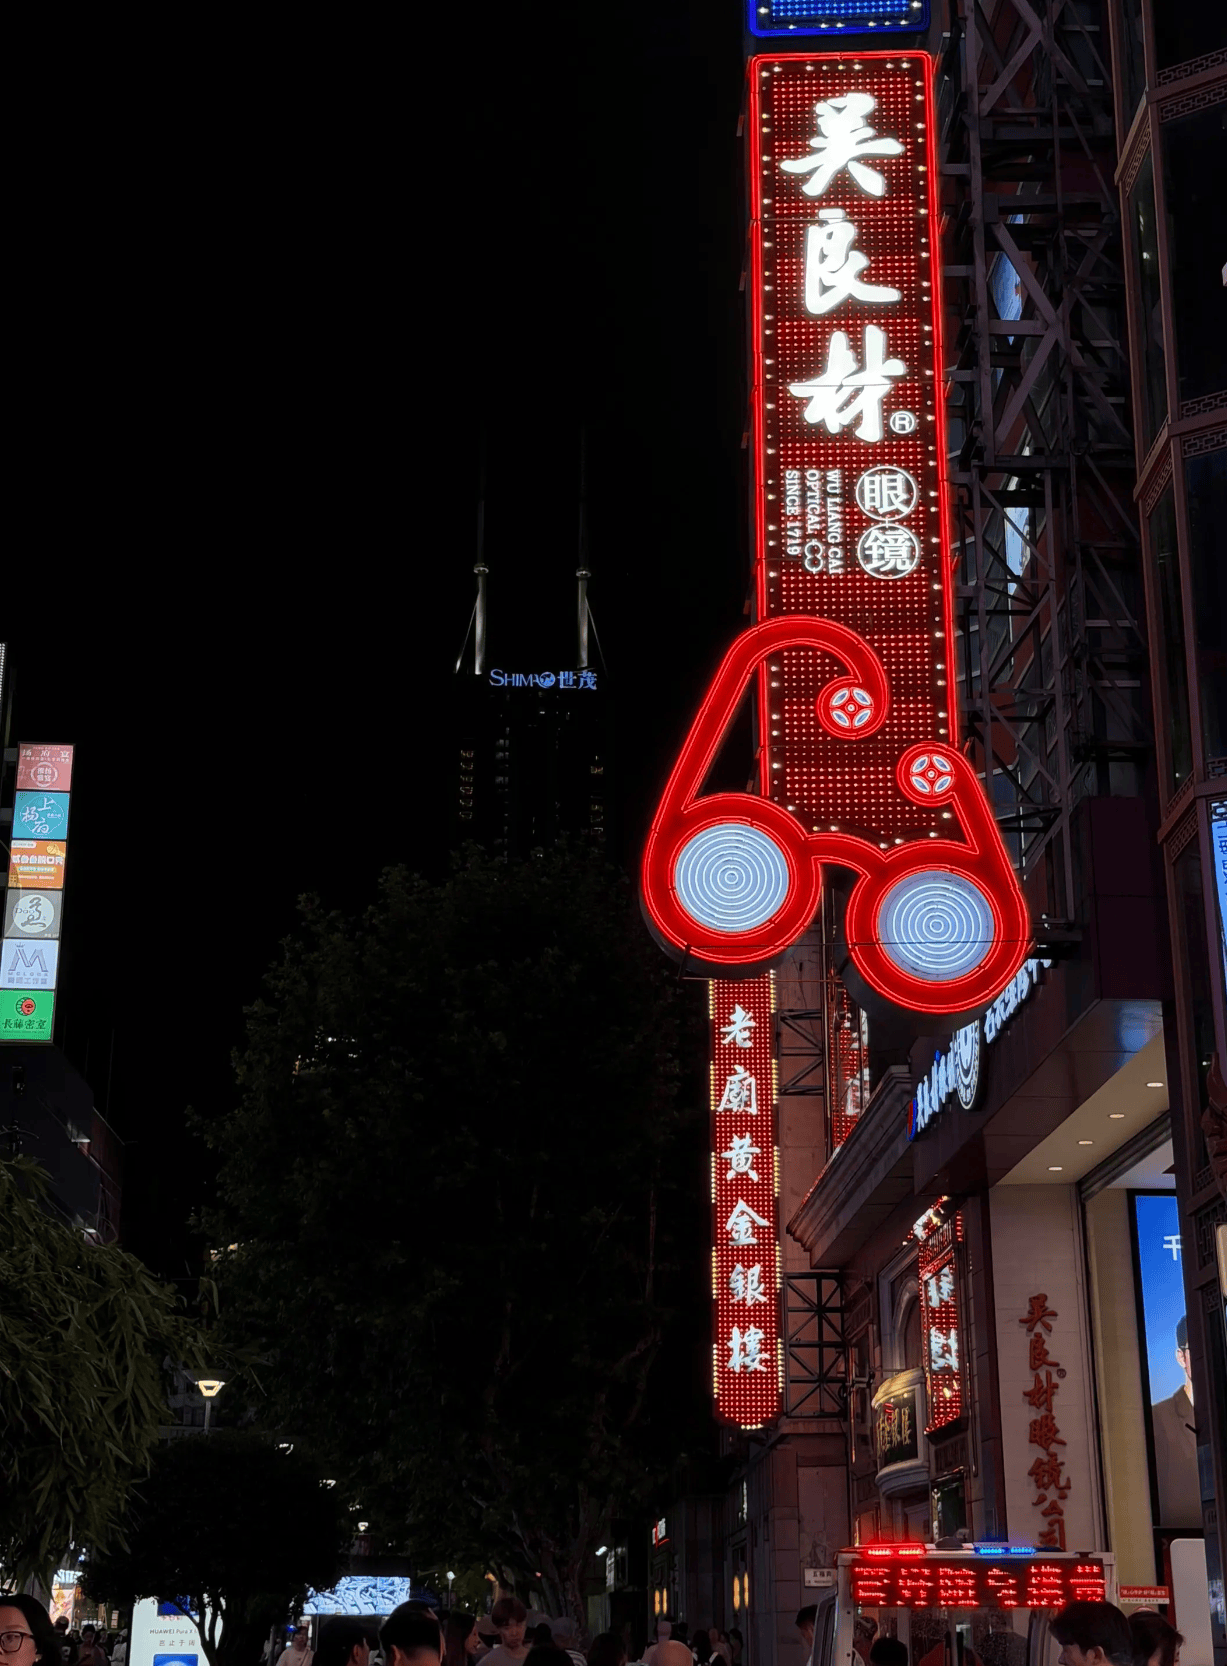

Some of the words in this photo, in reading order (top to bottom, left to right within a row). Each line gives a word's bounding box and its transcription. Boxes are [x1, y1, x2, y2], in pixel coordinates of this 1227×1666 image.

[778, 91, 905, 442] 吴良材
[785, 469, 799, 516] SINCE
[806, 469, 820, 534] OPTICAL
[826, 469, 842, 495] WU
[786, 521, 802, 556] 1719
[827, 497, 843, 544] LIANG
[827, 547, 845, 575] CAI
[557, 669, 598, 690] 世茂
